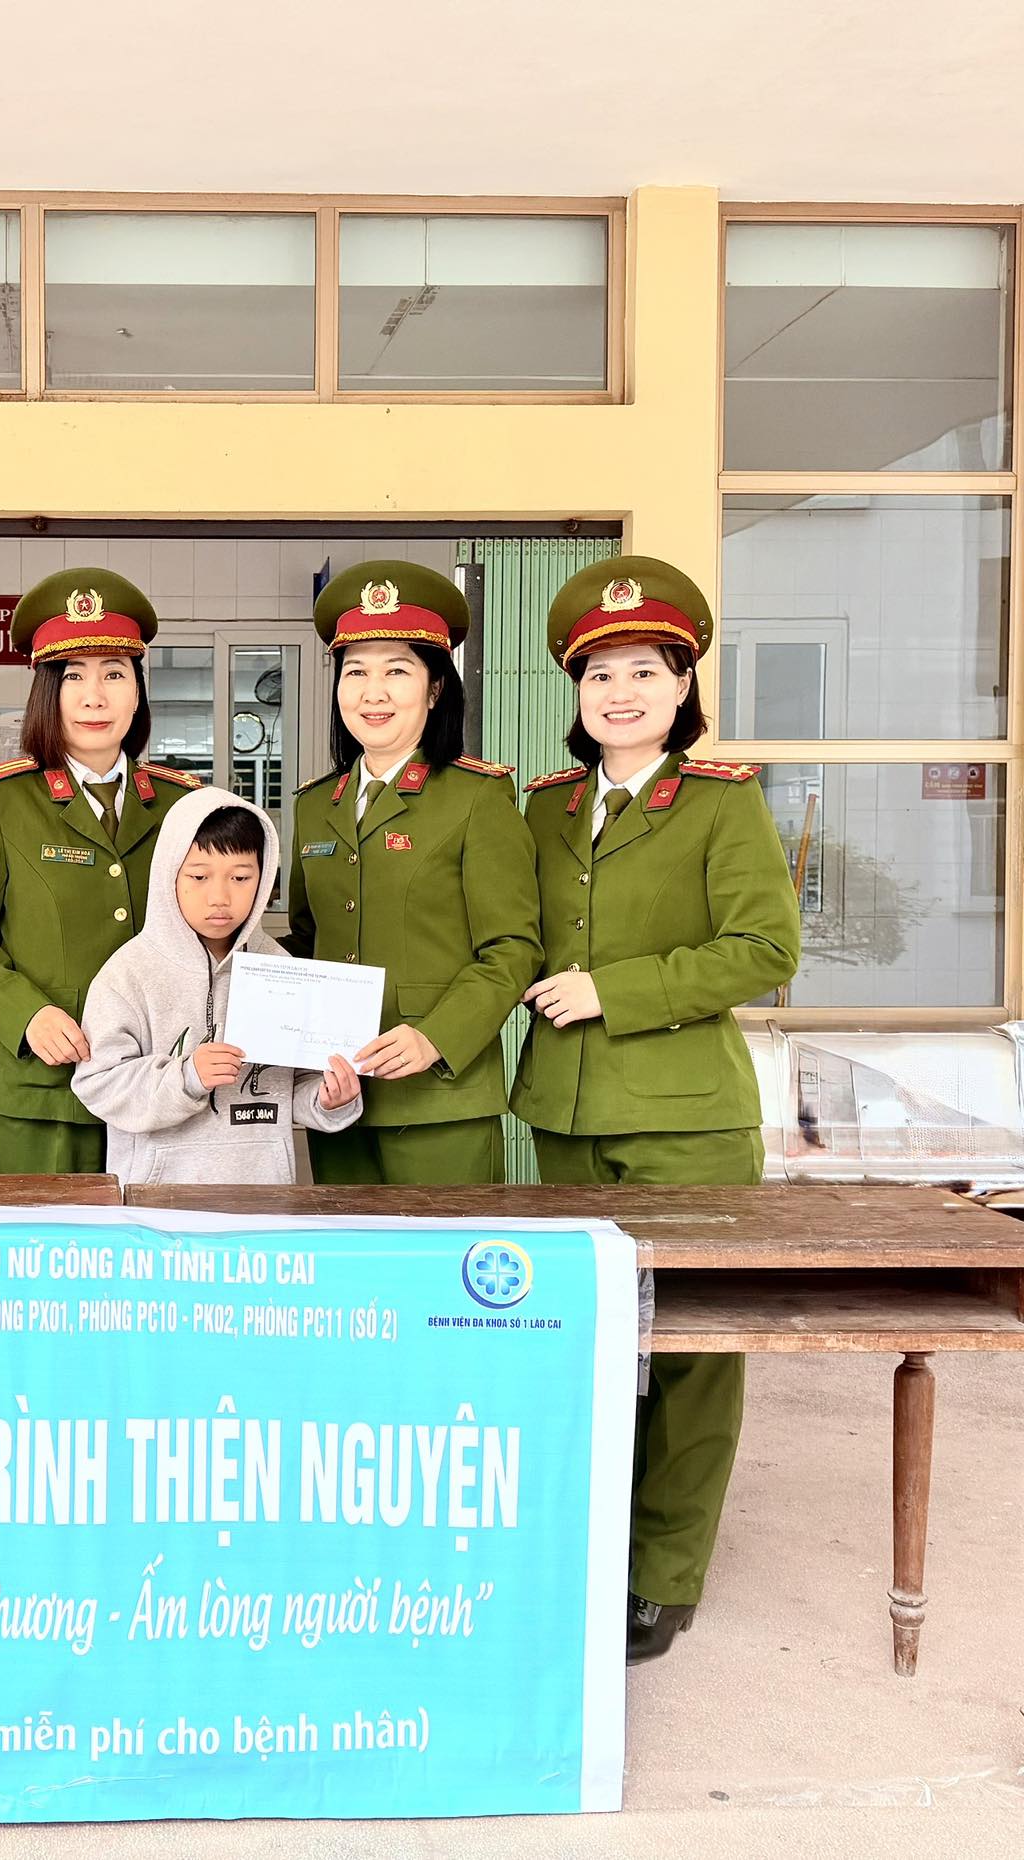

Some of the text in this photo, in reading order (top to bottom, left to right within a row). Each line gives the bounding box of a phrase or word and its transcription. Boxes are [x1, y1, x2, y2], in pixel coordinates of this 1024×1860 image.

[7, 1239, 45, 1279] NỮ
[49, 1240, 113, 1280] CÔNG
[120, 1246, 153, 1280] AN
[161, 1239, 215, 1283] TỈNH
[223, 1245, 268, 1284] LÀO
[275, 1251, 315, 1285] CAI
[28, 1299, 74, 1336] PX01,
[78, 1292, 132, 1333] PHÒNG
[137, 1300, 177, 1334] PC10
[182, 1315, 189, 1323] -
[193, 1302, 239, 1339] PK02,
[243, 1297, 298, 1338] PHÒNG
[303, 1306, 343, 1339] PC11
[350, 1296, 378, 1342] (SỐ
[381, 1308, 398, 1342] 2)
[428, 1316, 562, 1329] BỆNH VIỆN ĐA KHOA SỐ 1 LÀO CAI
[125, 1394, 281, 1547] THIỆN
[300, 1402, 521, 1552] NGUYỆN
[108, 1610, 121, 1622] -
[127, 1552, 189, 1641] Ấm
[198, 1576, 273, 1652] lòng
[281, 1575, 383, 1649] người
[90, 1717, 145, 1761] phí
[157, 1716, 221, 1756] cho
[232, 1715, 319, 1761] bệnh
[332, 1706, 430, 1753] nhân)
